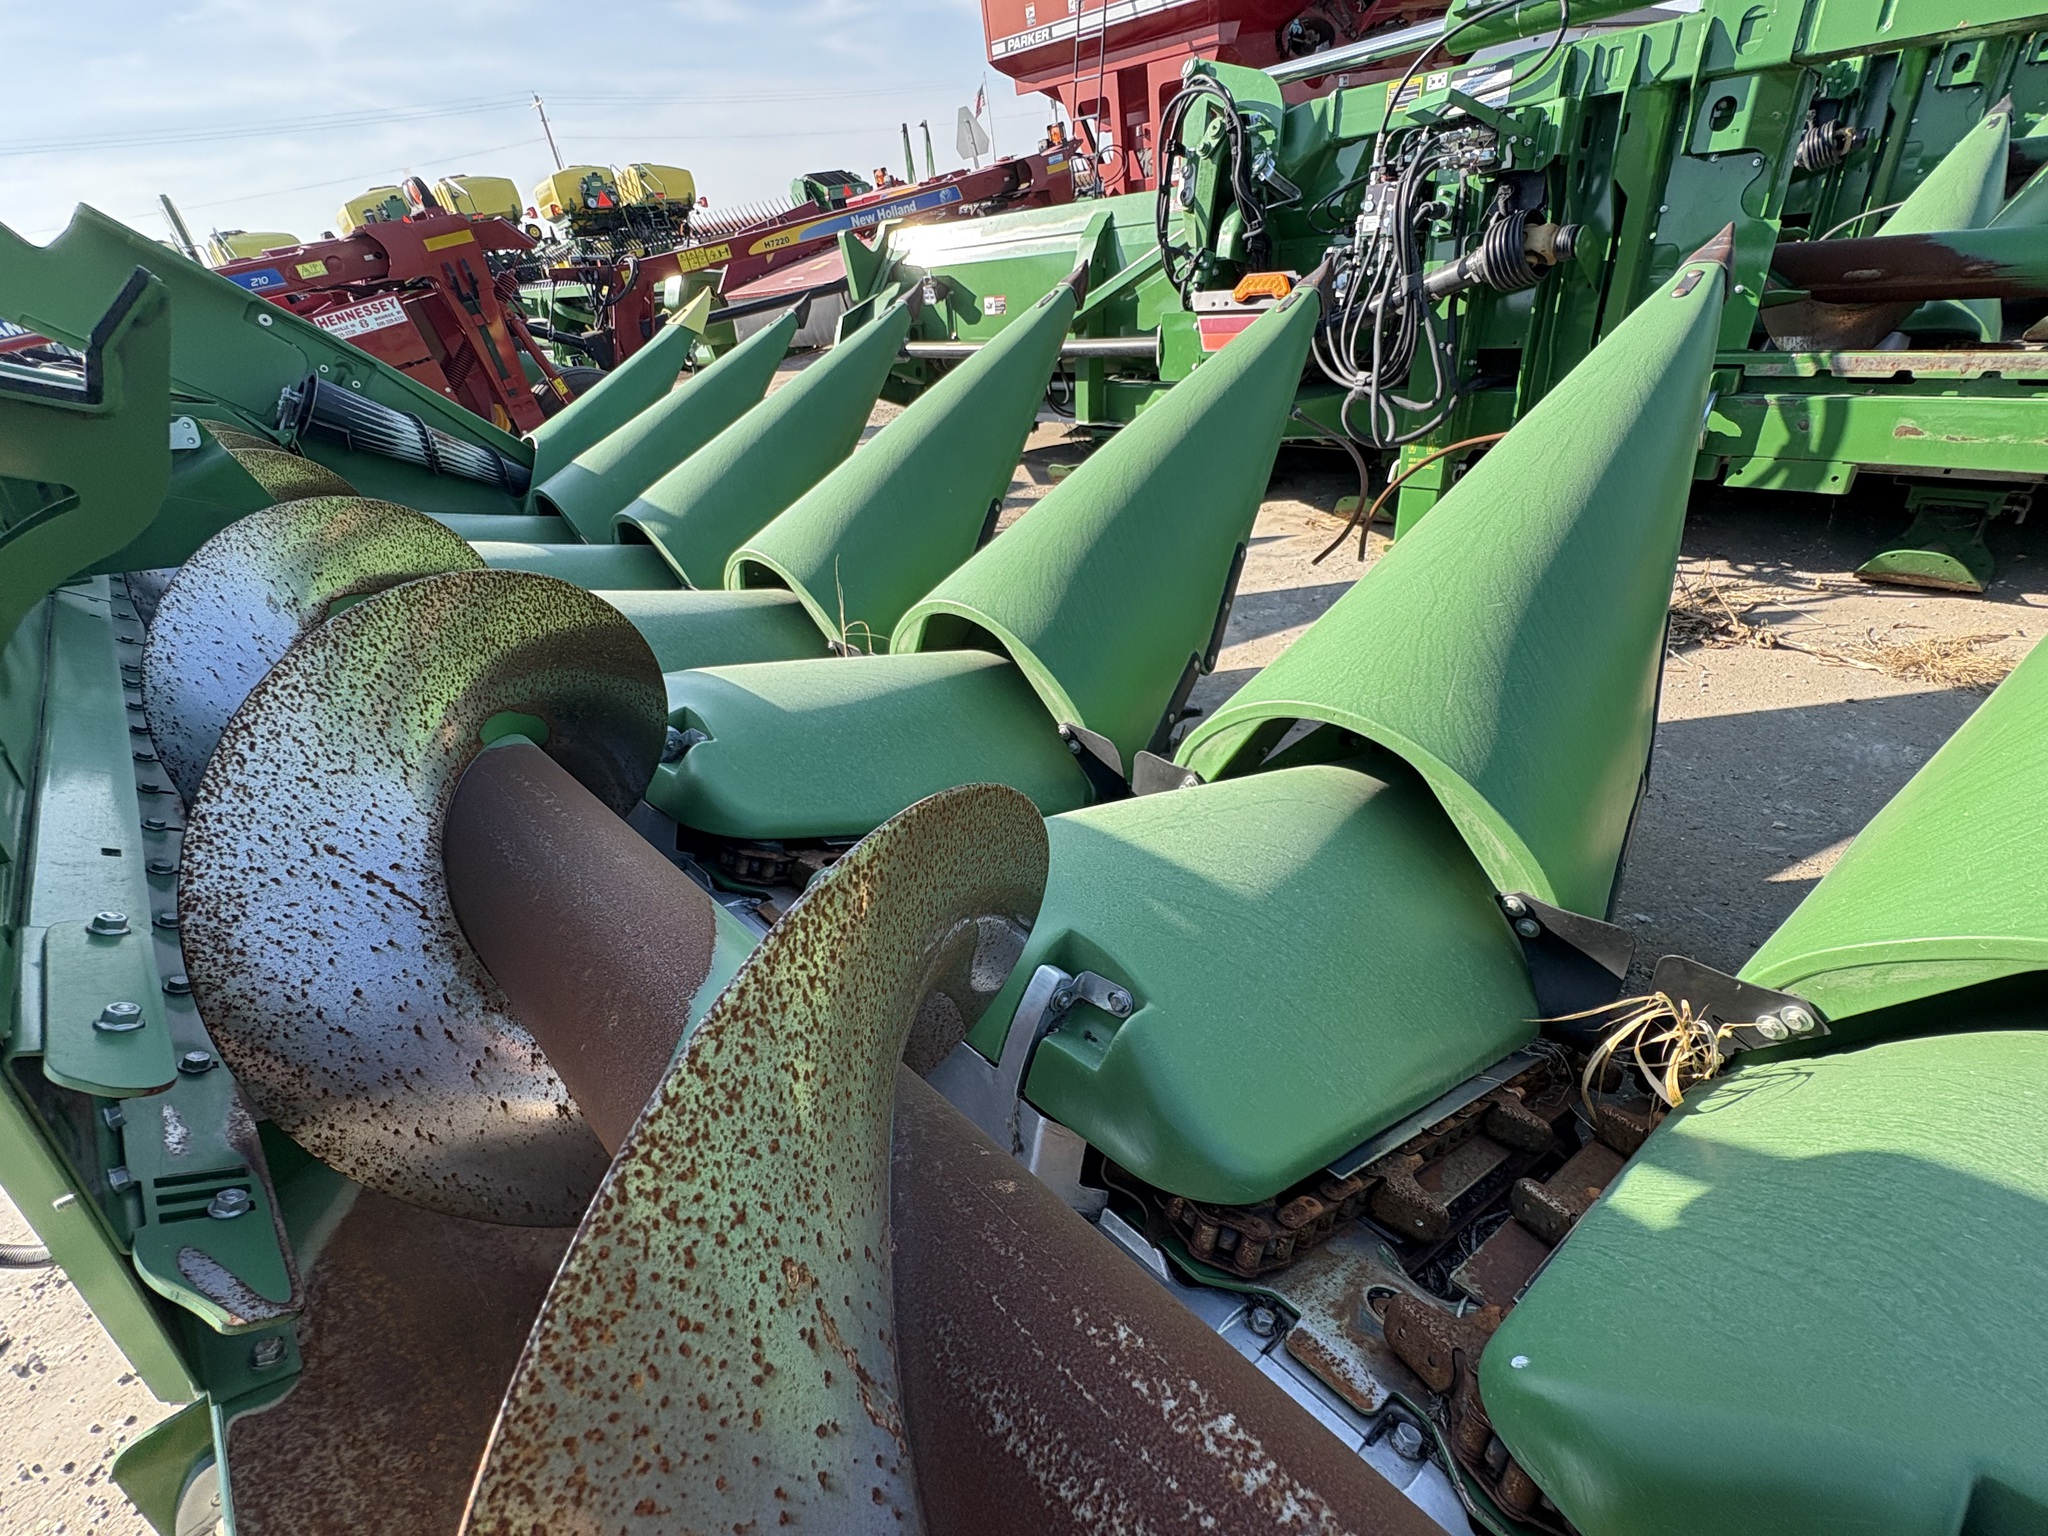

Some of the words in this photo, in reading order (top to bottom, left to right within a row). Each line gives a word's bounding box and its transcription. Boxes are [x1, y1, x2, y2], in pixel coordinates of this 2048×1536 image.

[1007, 28, 1050, 51] PARKER
[850, 214, 875, 228] New
[876, 200, 917, 220] Holland
[763, 236, 790, 249] H7220
[250, 276, 269, 287] 210
[316, 298, 397, 329] HENNESSEY
